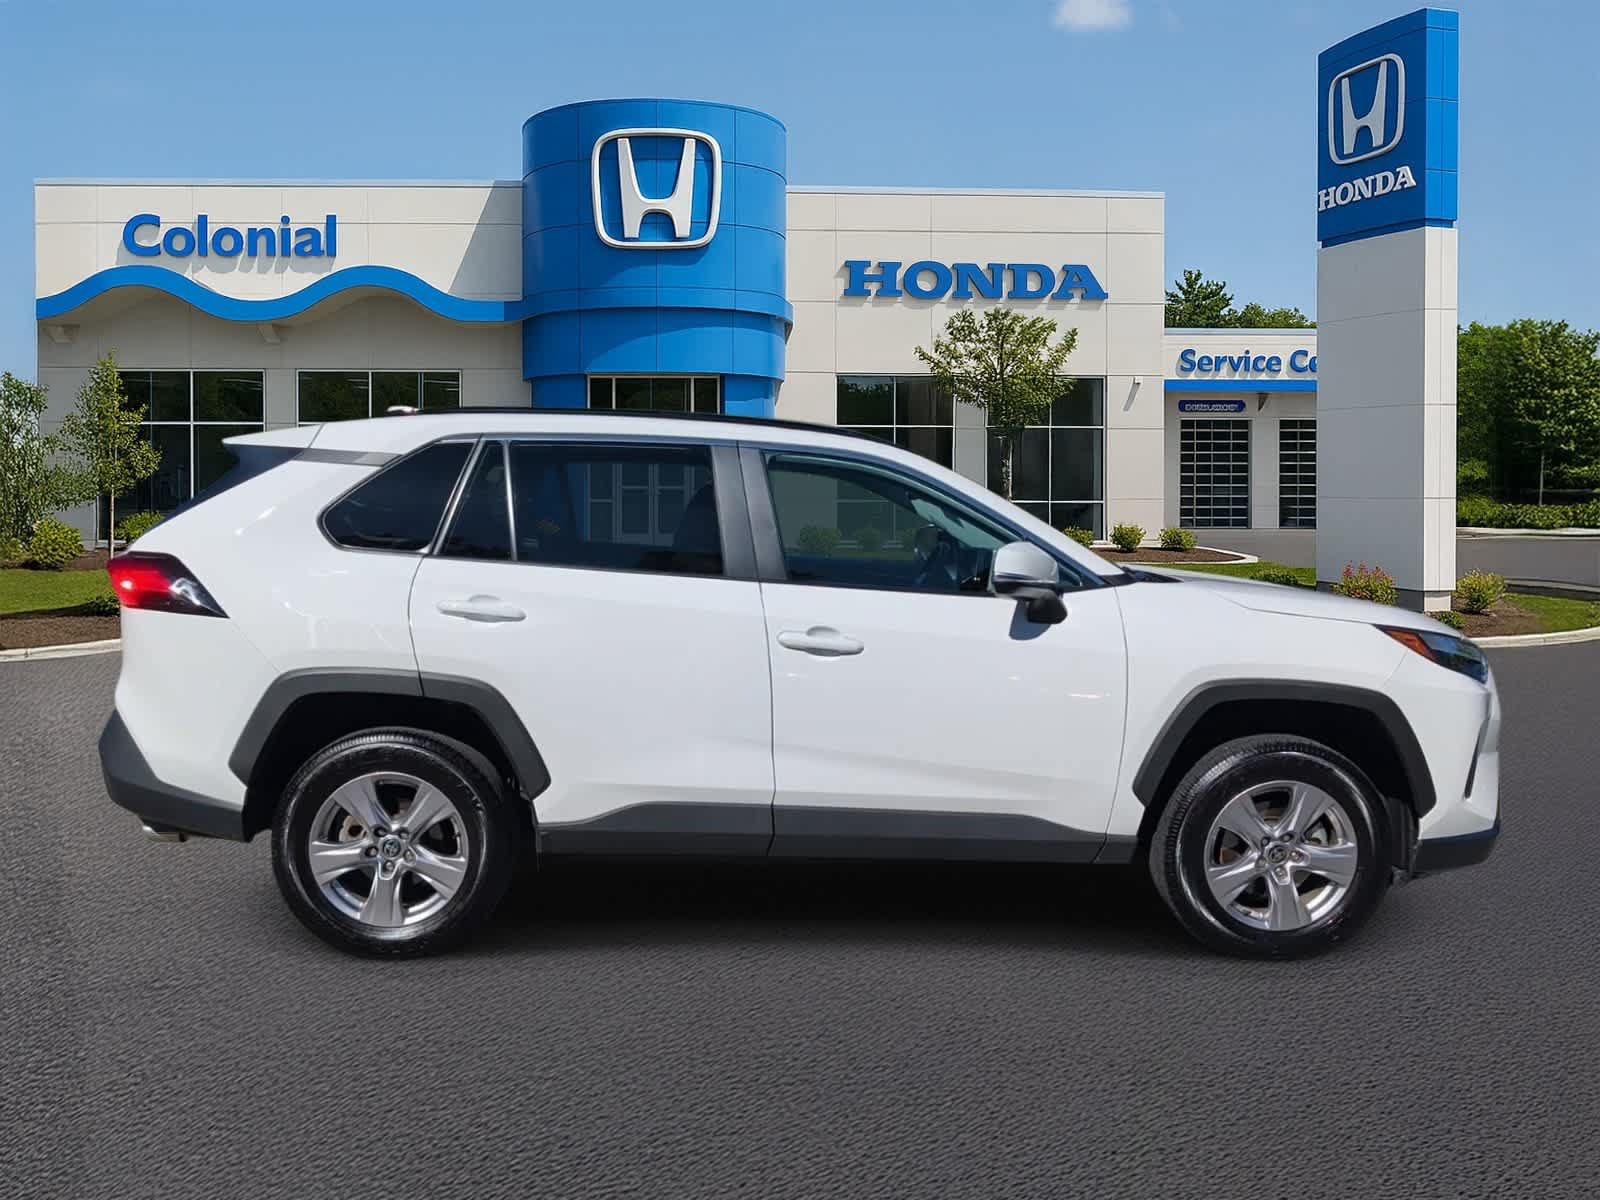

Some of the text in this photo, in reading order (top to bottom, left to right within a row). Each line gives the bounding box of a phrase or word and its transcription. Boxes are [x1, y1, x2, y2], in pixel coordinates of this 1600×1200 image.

[1318, 165, 1417, 212] HONDA
[122, 213, 338, 258] Colonial
[842, 259, 1109, 300] HONDA
[1180, 348, 1282, 373] Service
